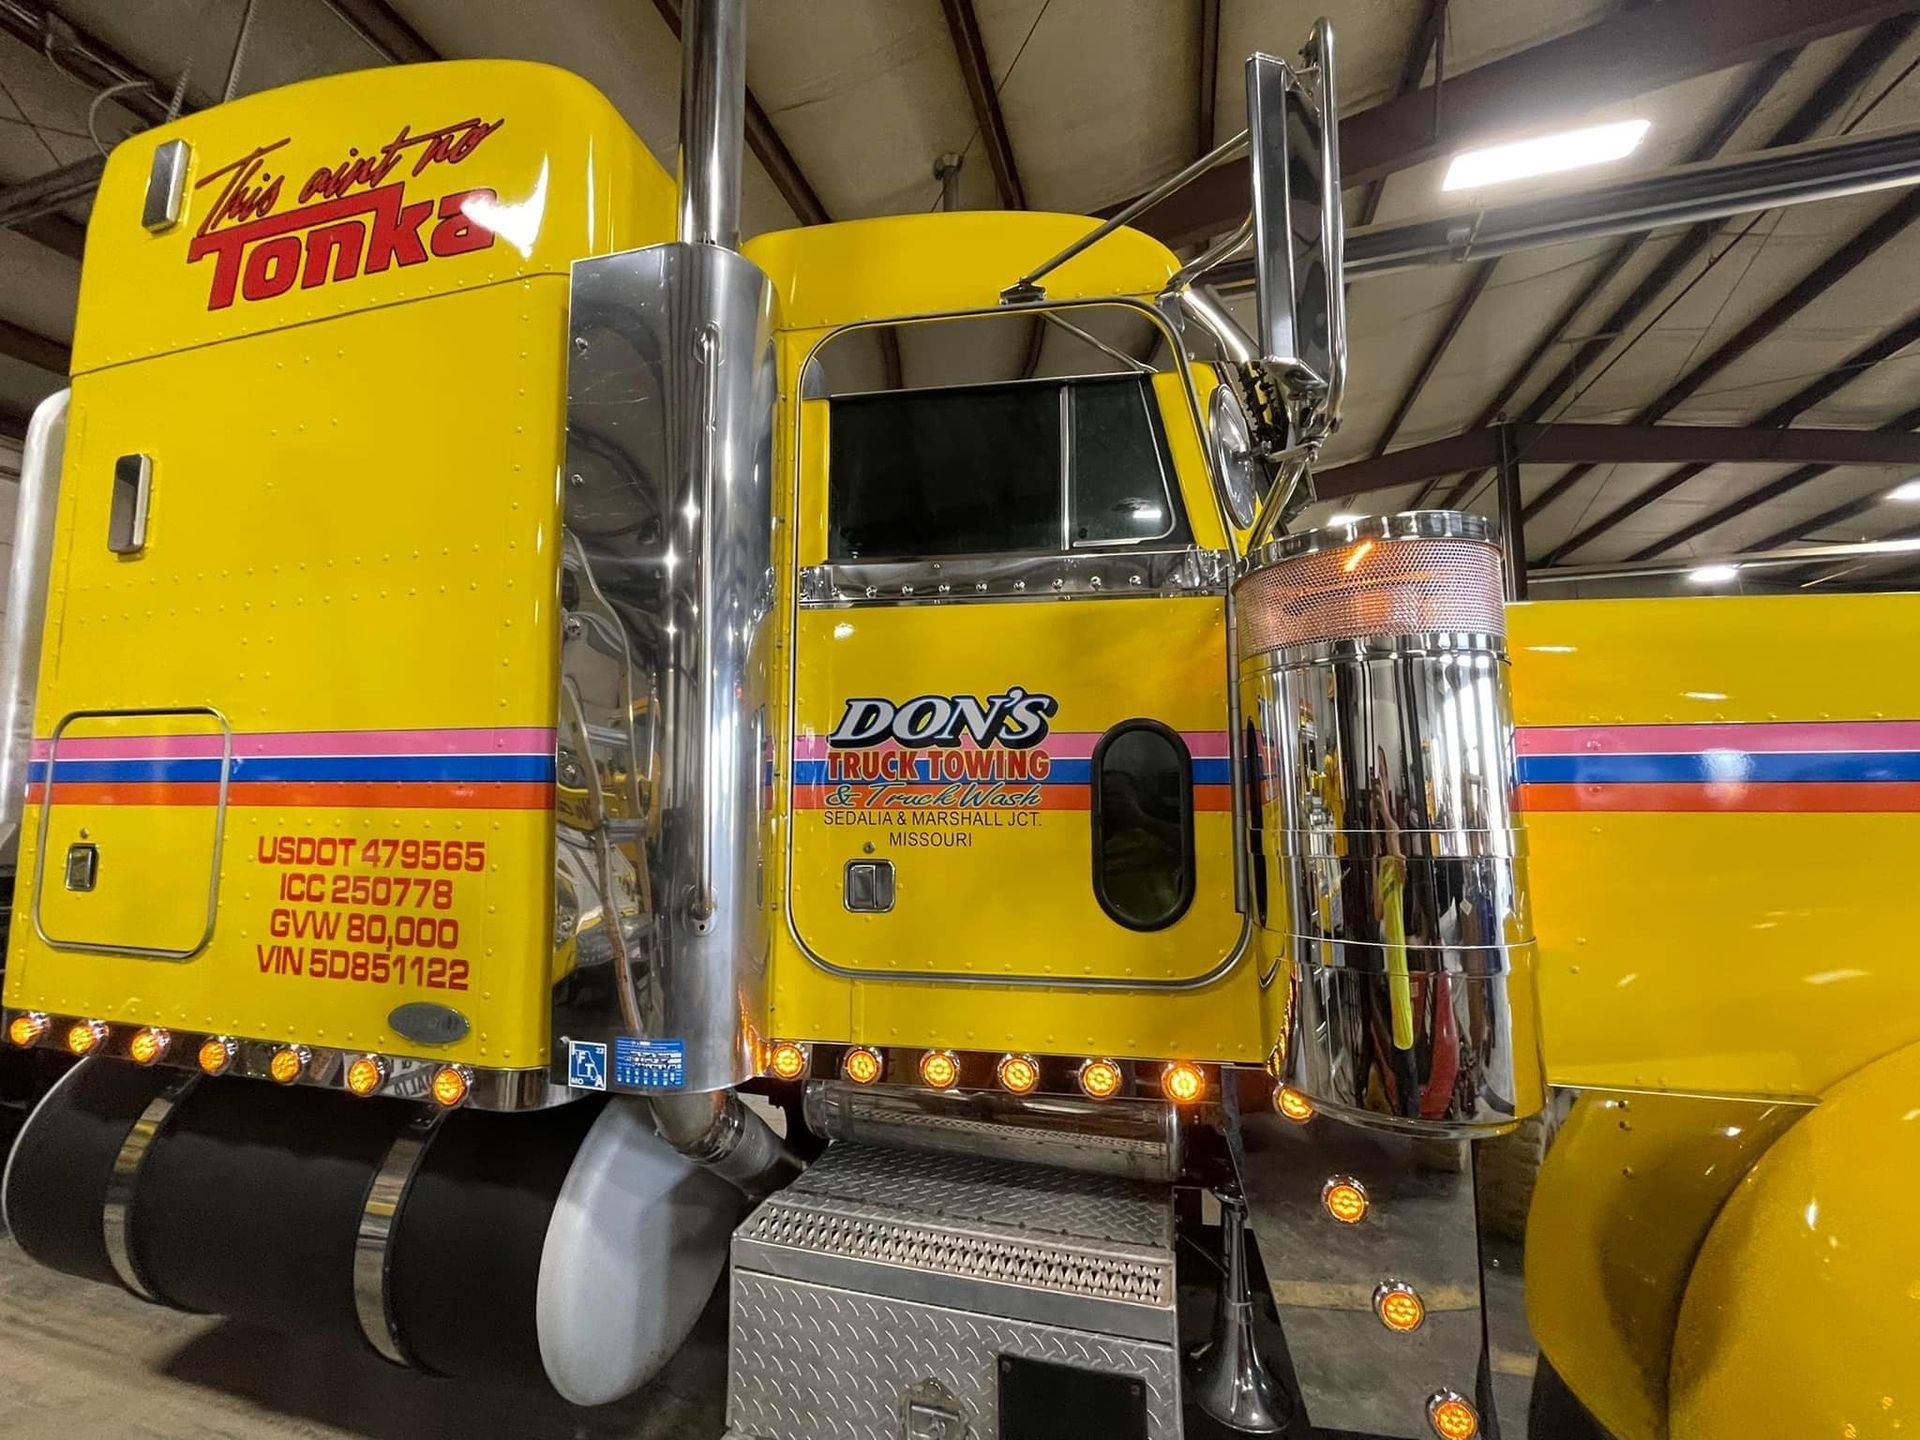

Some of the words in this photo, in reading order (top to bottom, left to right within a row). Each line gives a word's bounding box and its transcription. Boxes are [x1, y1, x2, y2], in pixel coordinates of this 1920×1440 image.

[194, 137, 291, 237] This
[298, 126, 406, 204] aint
[412, 118, 504, 177] no
[187, 181, 497, 311] Tonka
[826, 686, 1058, 749] DON'S
[827, 749, 919, 781] TRUCK
[927, 749, 1051, 781] TOWING
[825, 785, 860, 809] &
[864, 782, 959, 809] Truck
[959, 782, 1043, 809] Wash
[823, 810, 893, 826] SEDALIA
[896, 811, 908, 826] &
[912, 810, 1003, 827] MARSHALL
[1007, 811, 1042, 827] JCT.
[257, 836, 357, 867] USDOT
[361, 838, 486, 873] 479565
[889, 832, 972, 847] MISSOURI
[280, 872, 326, 903] ICC
[331, 874, 453, 910] 250778
[270, 908, 342, 940] GVW
[346, 912, 459, 952] 80,000
[256, 944, 304, 975] VIN
[308, 948, 469, 991] 5D851122
[571, 1077, 584, 1086] MO
